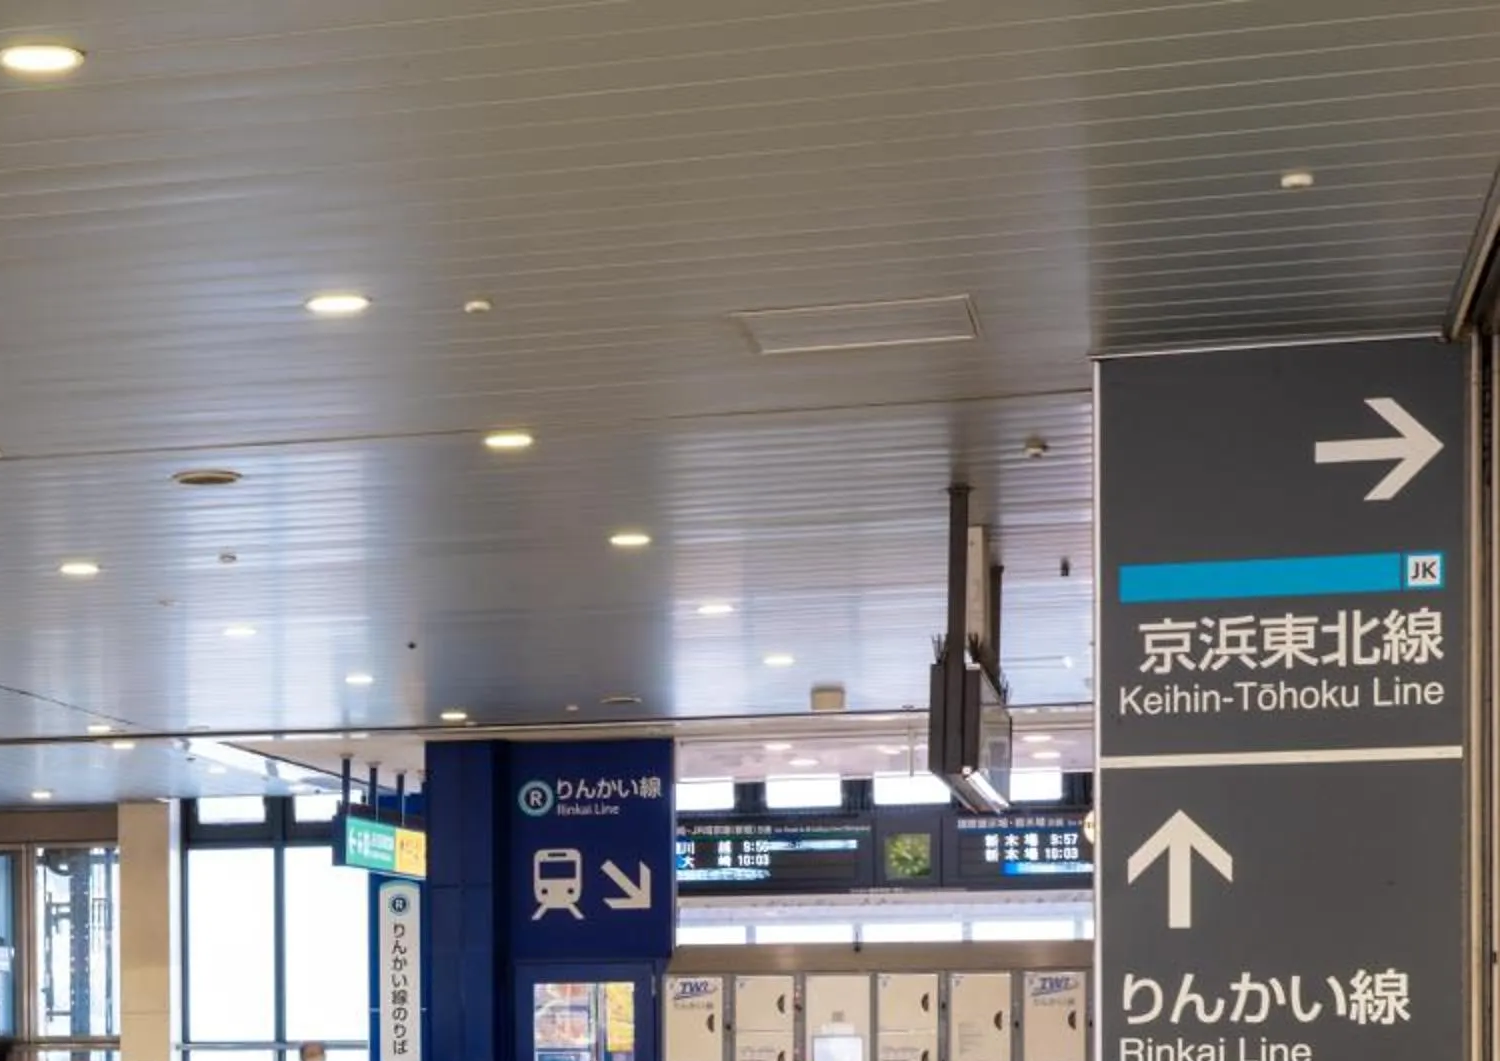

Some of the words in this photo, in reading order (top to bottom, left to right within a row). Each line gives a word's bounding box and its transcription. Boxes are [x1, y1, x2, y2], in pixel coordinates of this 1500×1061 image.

[1411, 560, 1437, 580] JK
[1138, 607, 1445, 675] 京浜東北線
[1119, 680, 1360, 715] Keihin-Tōhoku
[1373, 677, 1445, 708] Line
[557, 776, 661, 799] りんかい線
[557, 804, 593, 815] Rinkai
[595, 803, 620, 815] Line
[391, 922, 409, 1056] りんかい線のりば
[1122, 969, 1412, 1025] りんかい線
